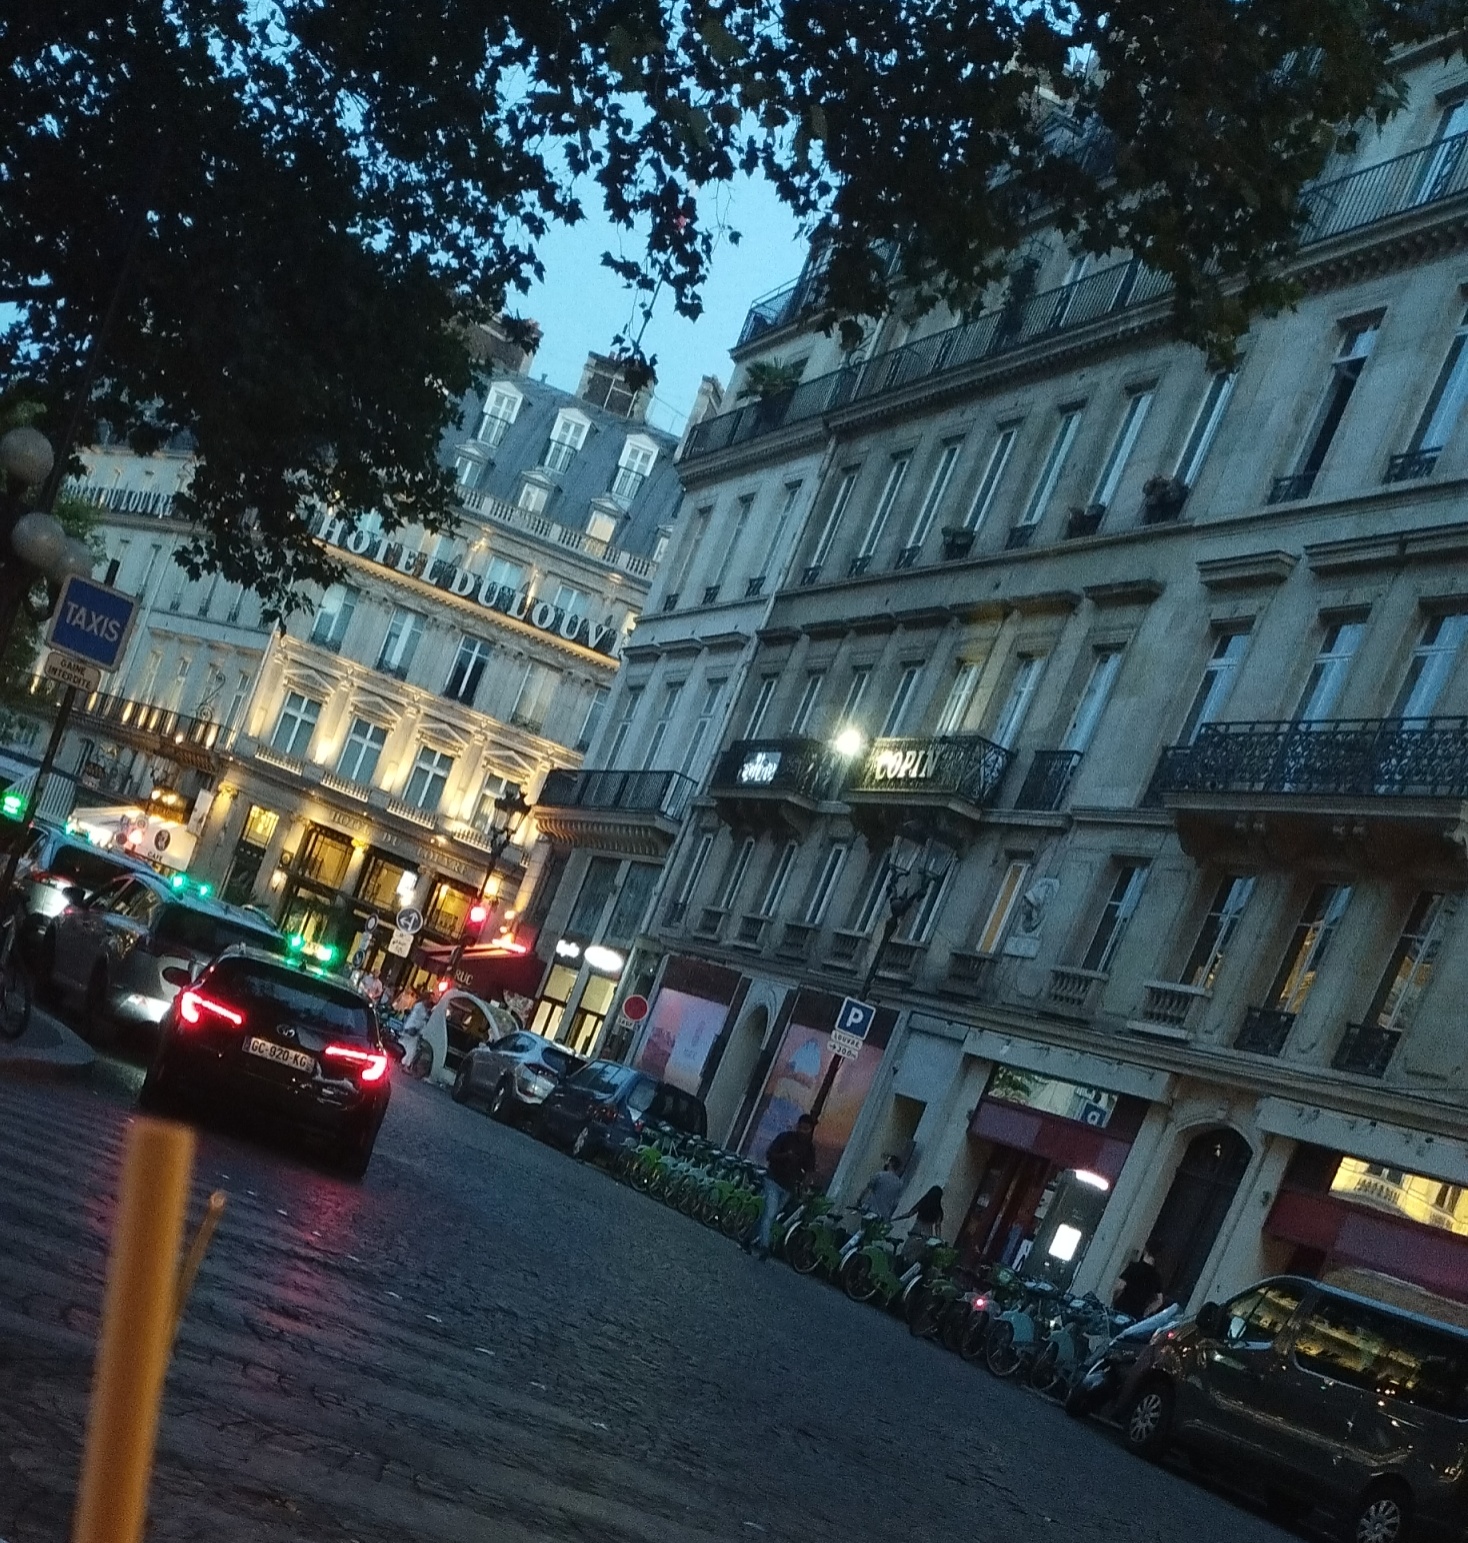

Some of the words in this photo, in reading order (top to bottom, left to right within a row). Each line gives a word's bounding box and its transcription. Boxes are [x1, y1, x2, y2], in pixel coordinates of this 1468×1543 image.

[119, 489, 173, 517] LOUVRE
[448, 567, 501, 608] DU
[65, 601, 120, 642] TAXIS
[48, 666, 91, 689] INTERDITE
[846, 1006, 864, 1028] P
[251, 1040, 307, 1067] GC-920-KG
